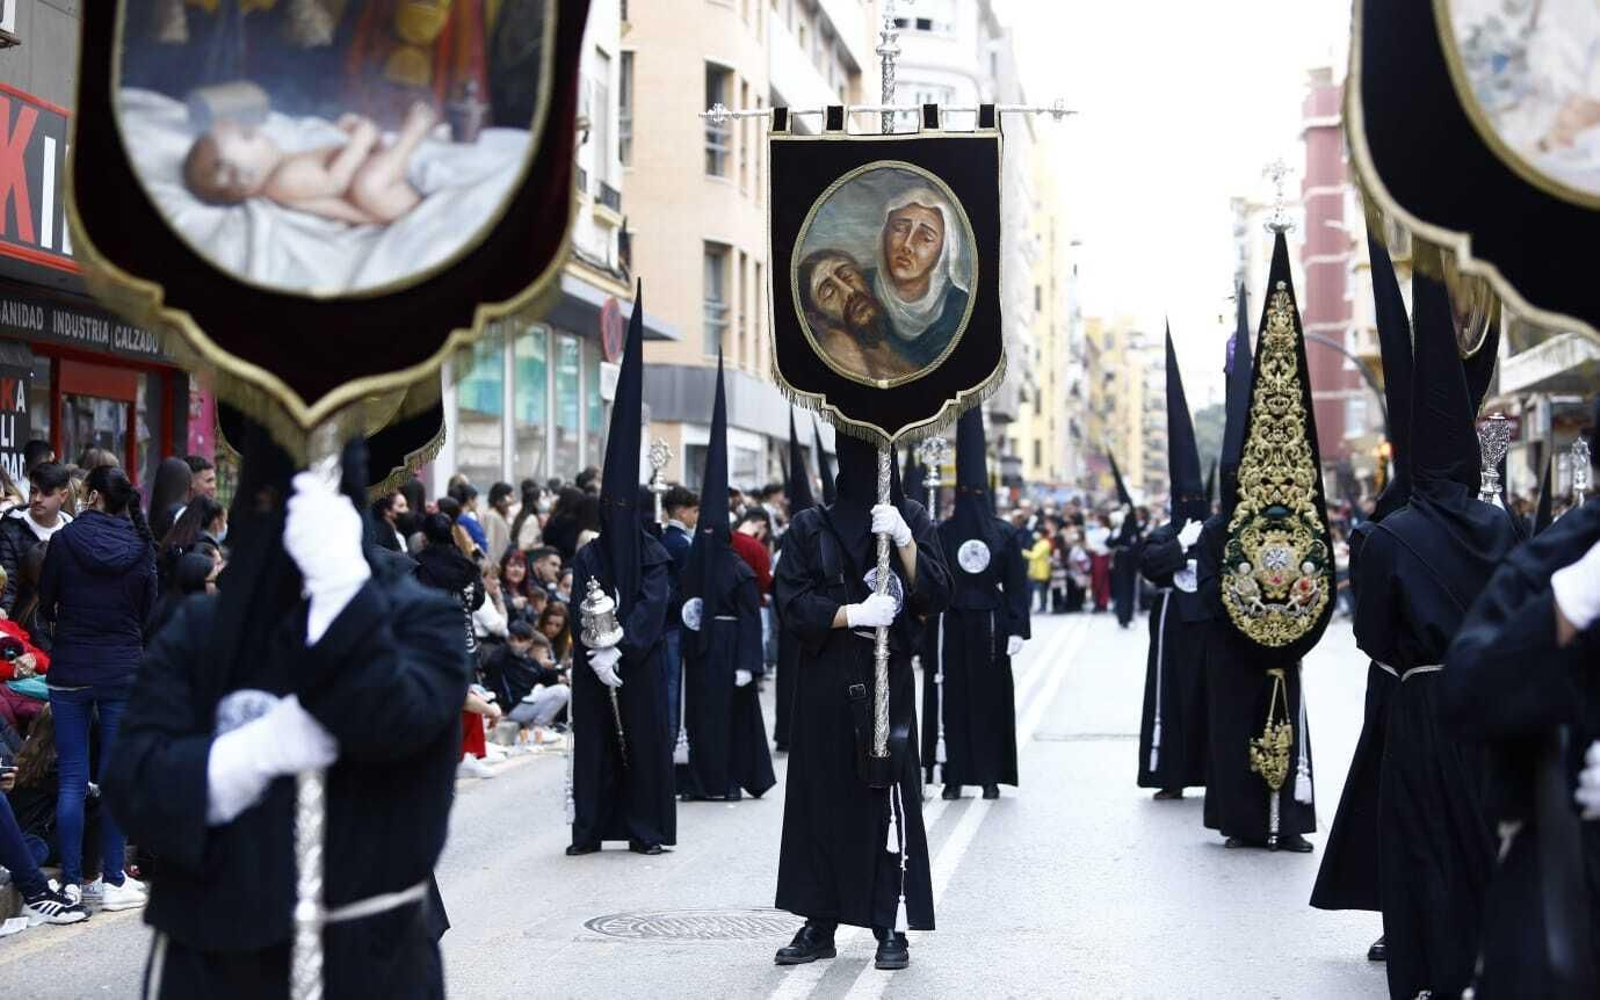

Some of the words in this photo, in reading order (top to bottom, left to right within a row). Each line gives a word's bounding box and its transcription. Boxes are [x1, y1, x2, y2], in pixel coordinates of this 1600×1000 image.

[0, 95, 73, 256] KI
[0, 299, 44, 331] ANIDAD
[53, 309, 109, 344] INDUSTRIA
[115, 325, 159, 354] CALZADO
